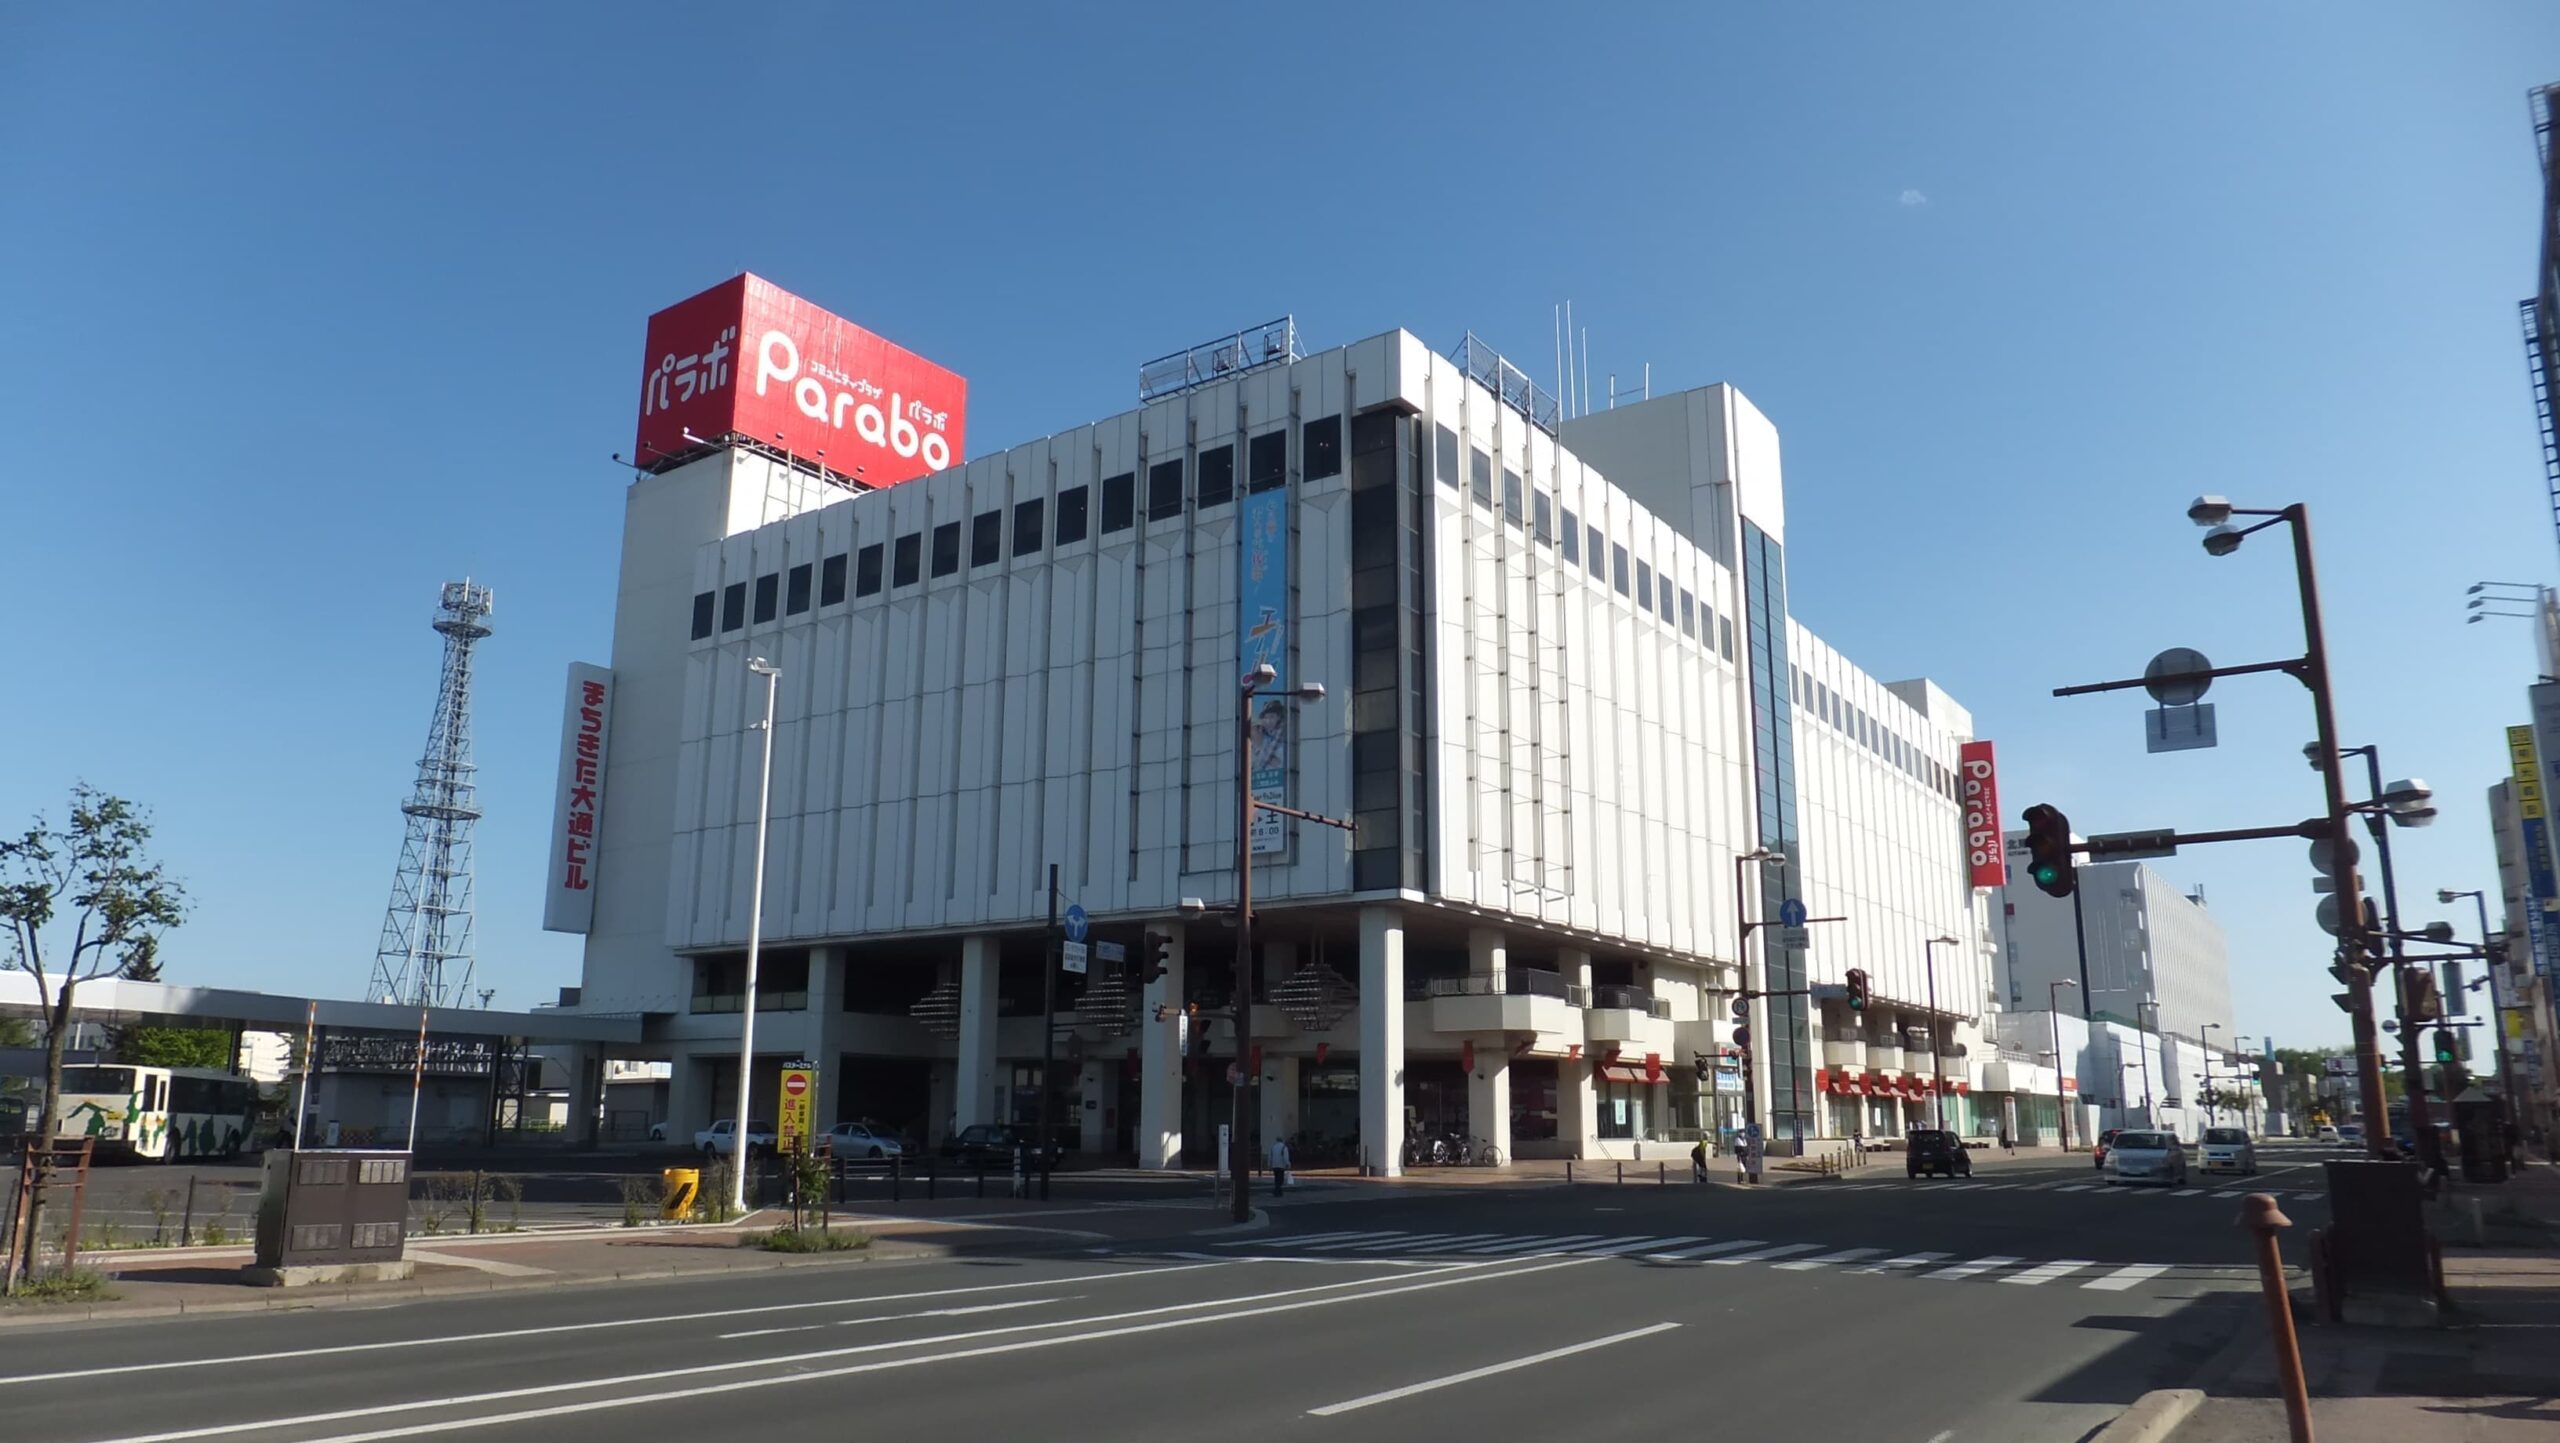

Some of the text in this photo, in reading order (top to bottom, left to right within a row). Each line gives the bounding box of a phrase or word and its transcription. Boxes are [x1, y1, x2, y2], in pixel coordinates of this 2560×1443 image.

[646, 325, 736, 416] パラボ
[811, 359, 882, 399] コミュニティプラザ
[908, 400, 948, 431] パラボ
[564, 680, 605, 890] まちきた大通ビル
[1987, 840, 2000, 864] パラボ
[783, 1098, 796, 1151] 進入禁止
